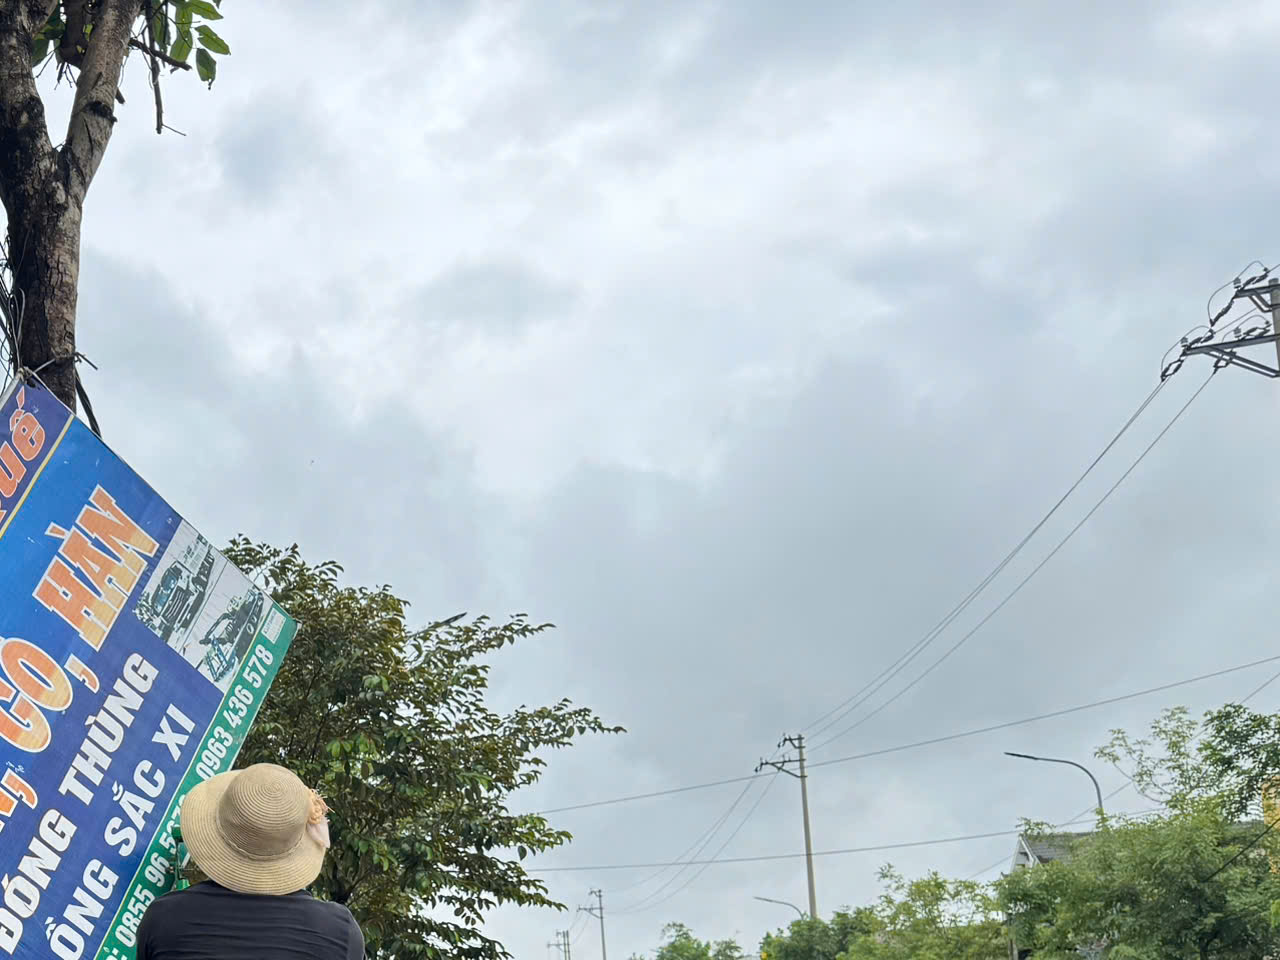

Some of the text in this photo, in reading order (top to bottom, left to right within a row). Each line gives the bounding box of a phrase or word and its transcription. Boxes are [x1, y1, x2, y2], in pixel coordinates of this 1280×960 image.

[32, 483, 160, 652] HÀN
[58, 652, 161, 806] THÙNG
[104, 759, 166, 858] SẮC
[151, 703, 197, 762] XI
[115, 884, 156, 948] 0855
[144, 852, 170, 888] 96
[159, 794, 186, 855] 57
[195, 725, 233, 780] 0963
[223, 683, 253, 729] 436
[247, 643, 274, 691] 578
